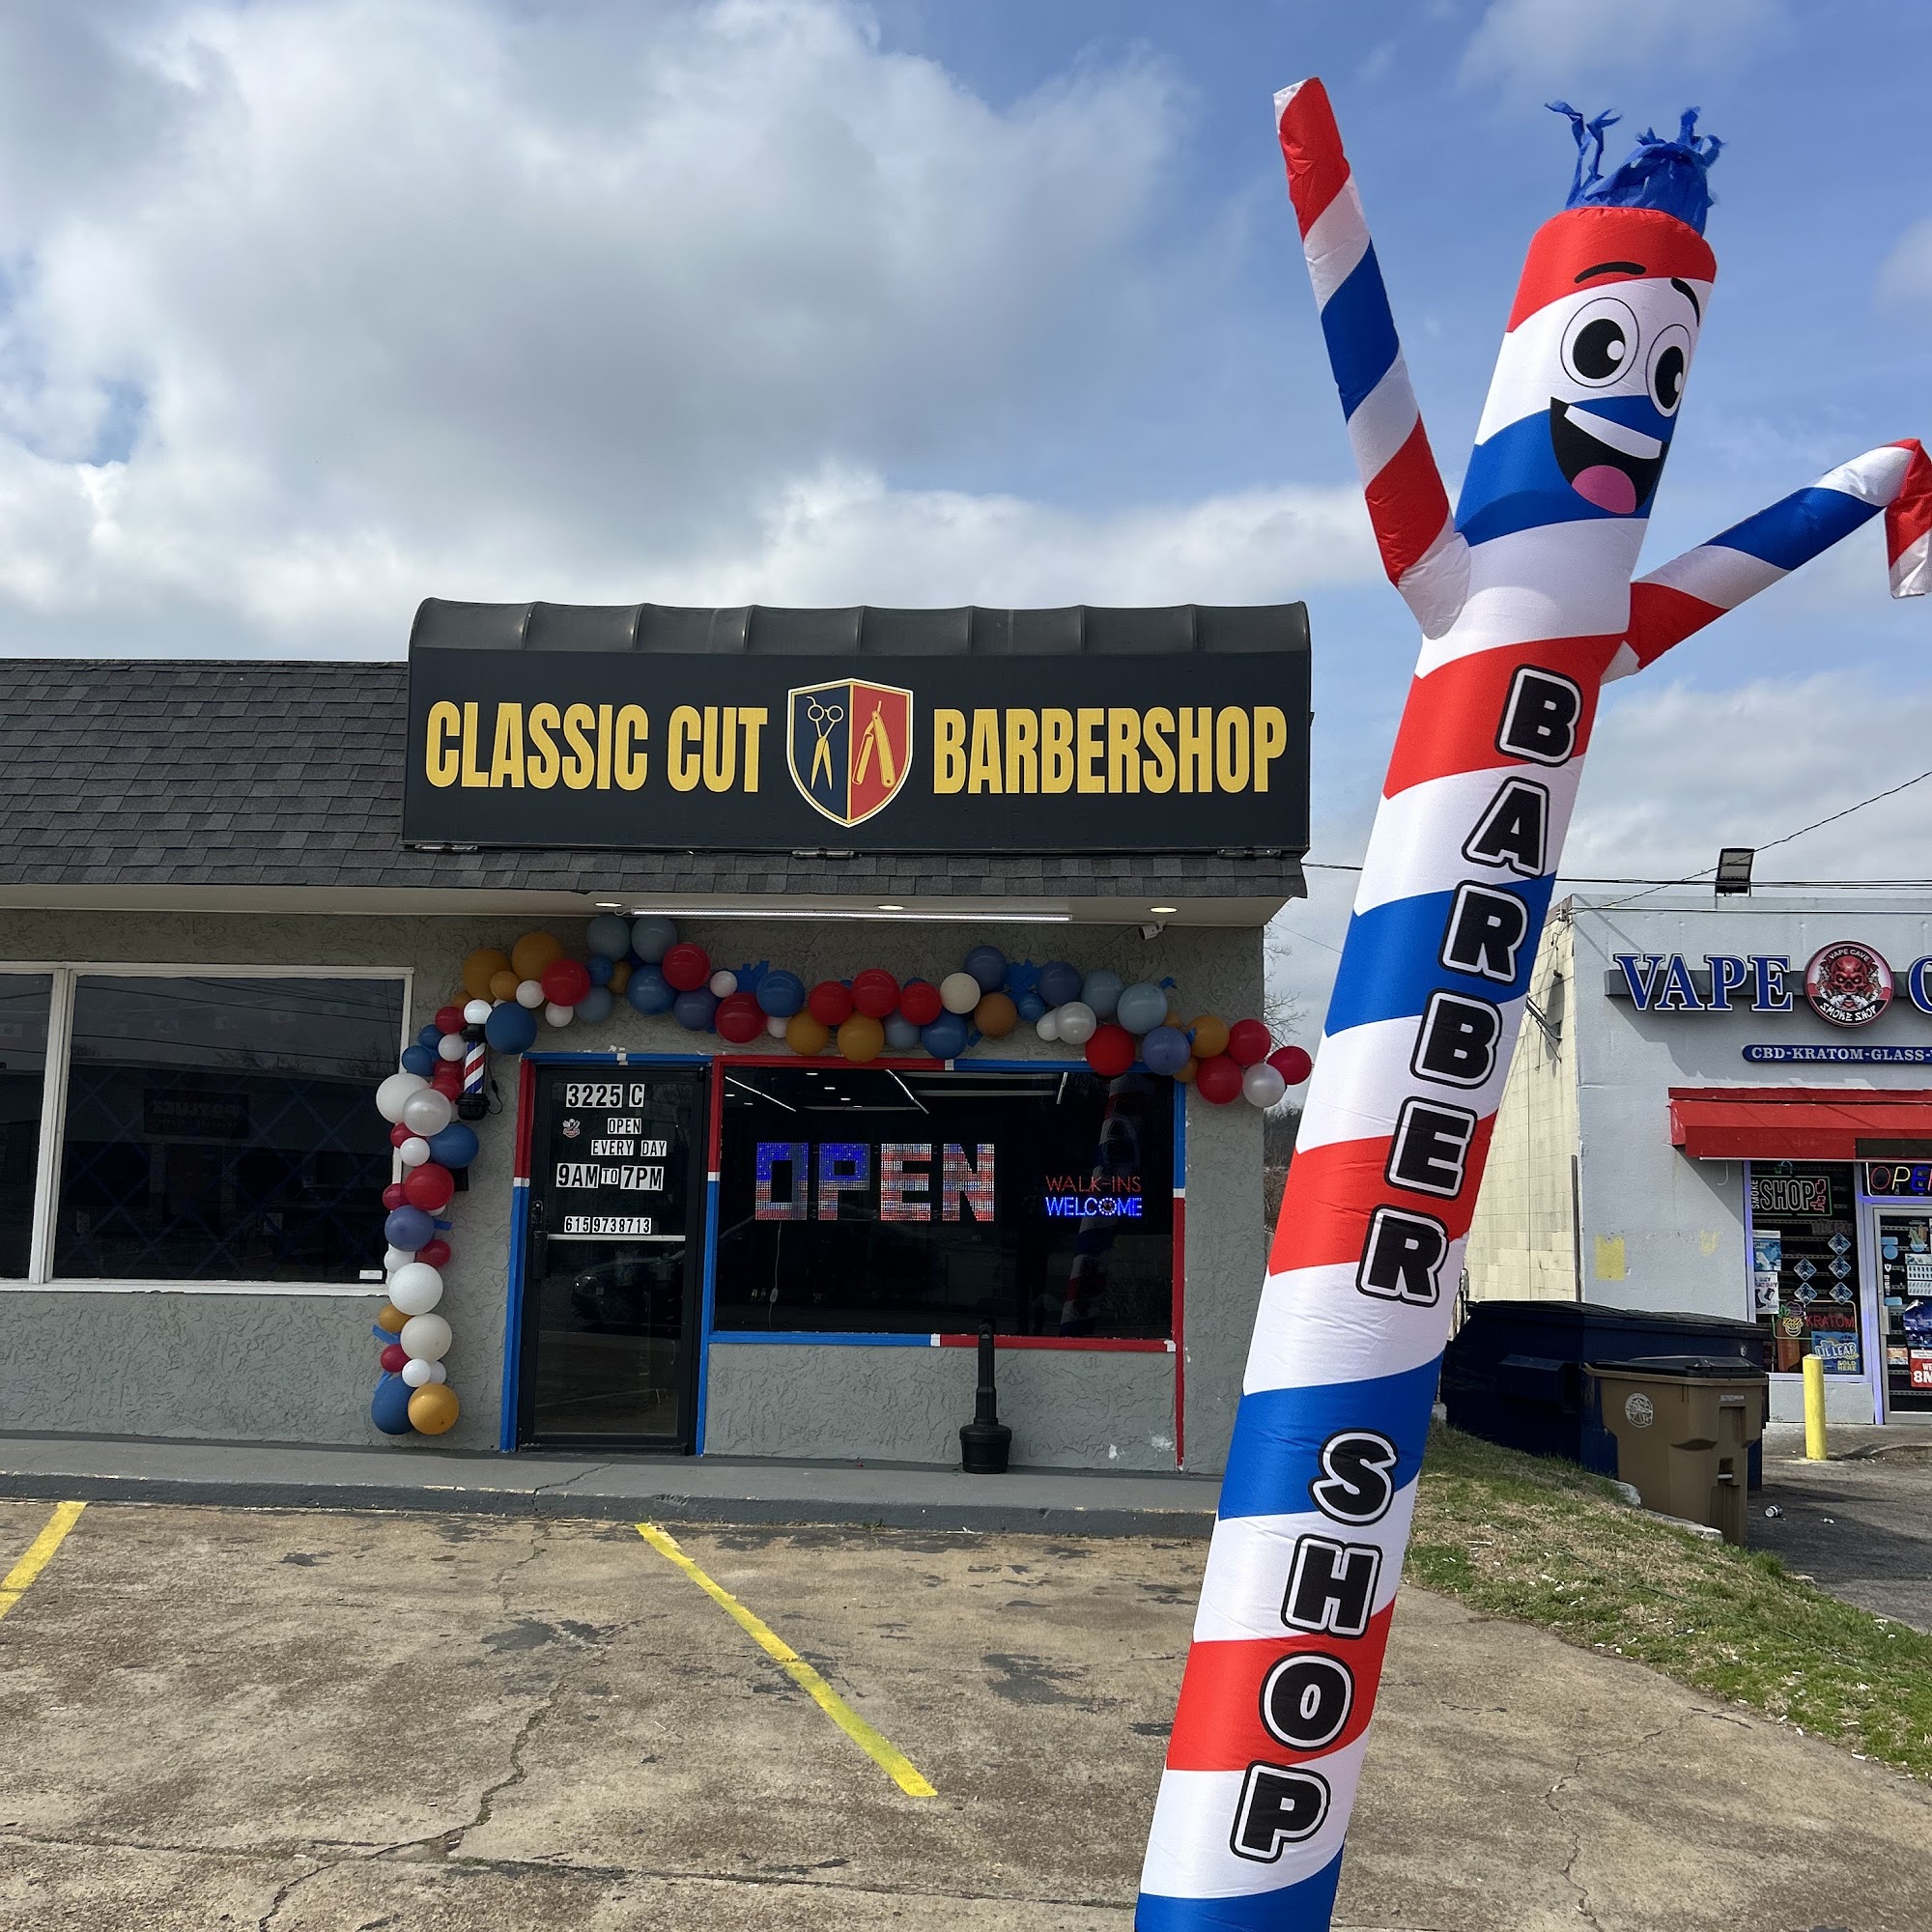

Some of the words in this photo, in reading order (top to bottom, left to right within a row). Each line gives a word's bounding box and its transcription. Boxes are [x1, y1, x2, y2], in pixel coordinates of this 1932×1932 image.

[425, 700, 649, 791] CLASSIC
[667, 705, 769, 793] CUT
[933, 705, 1288, 794] BARBERSHOP
[1828, 949, 1848, 960] VAPE
[1850, 949, 1870, 962] CAVE
[1355, 664, 1584, 1307] BARBER
[1614, 953, 1794, 1011] VAPE
[1820, 1002, 1853, 1022] SMOKE
[1854, 1005, 1877, 1022] SHOP
[567, 1085, 621, 1107] 3225
[631, 1085, 643, 1107] C
[609, 1119, 641, 1133] OPEN
[592, 1141, 634, 1155] EVERY
[642, 1142, 666, 1155] DAY
[557, 1164, 599, 1188] 9AM
[603, 1170, 618, 1183] TO
[623, 1166, 663, 1189] 7PM
[755, 1142, 995, 1221] OPEN
[1044, 1176, 1142, 1193] WALK-INS
[1870, 1166, 1932, 1190] OPE
[1750, 1179, 1760, 1209] SMOKE
[1760, 1179, 1816, 1210] SHOP
[1044, 1196, 1143, 1216] WELCOME
[565, 1217, 589, 1233] 615
[593, 1217, 650, 1234] 9738713
[1805, 1315, 1855, 1327] KRATOM
[1817, 1346, 1832, 1357] LIL
[1832, 1344, 1856, 1356] LEAF
[1230, 1428, 1399, 1863] SHOP
